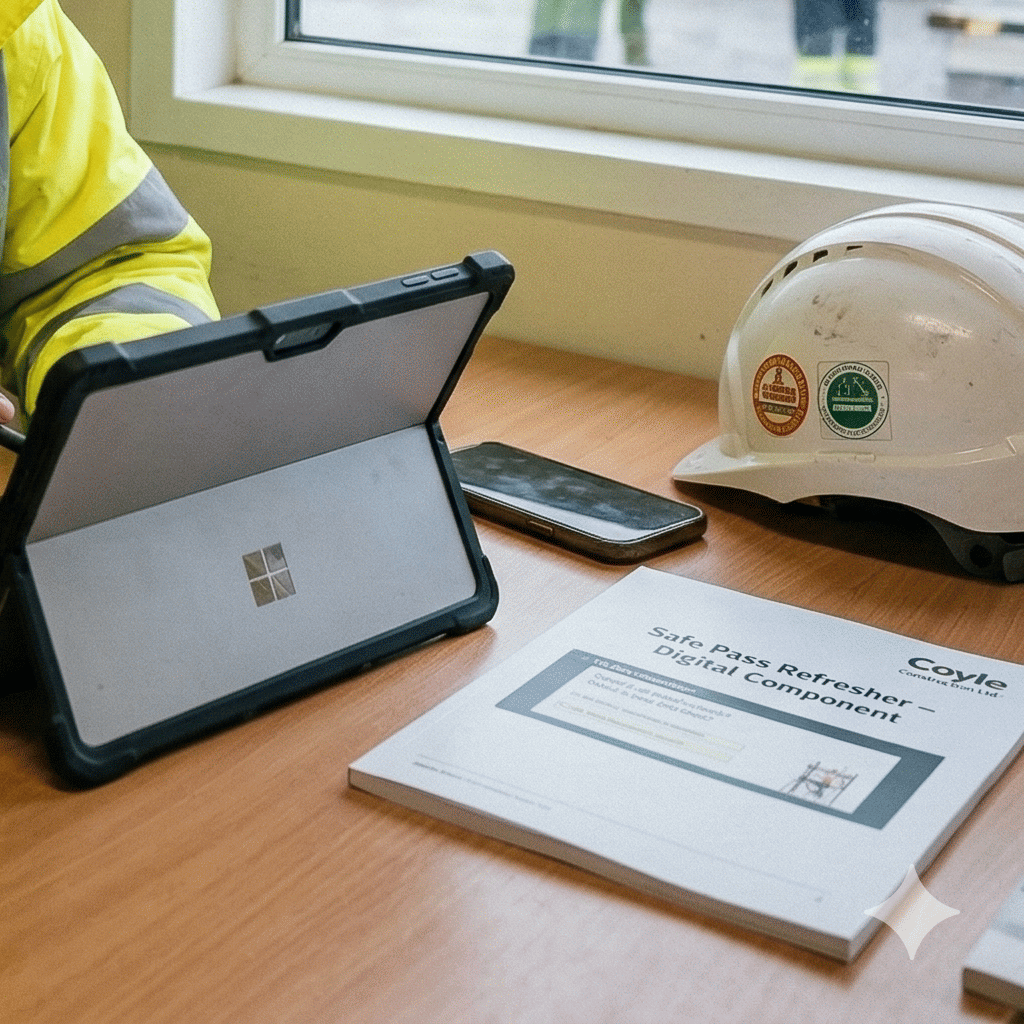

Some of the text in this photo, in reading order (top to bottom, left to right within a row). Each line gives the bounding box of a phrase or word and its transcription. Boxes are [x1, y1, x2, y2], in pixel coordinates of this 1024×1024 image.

[648, 626, 704, 650] Safe
[710, 644, 772, 669] Pass
[777, 663, 913, 708] Refresher
[653, 644, 740, 677] Digital
[744, 672, 902, 724] Component
[908, 657, 1008, 690] Coyle
